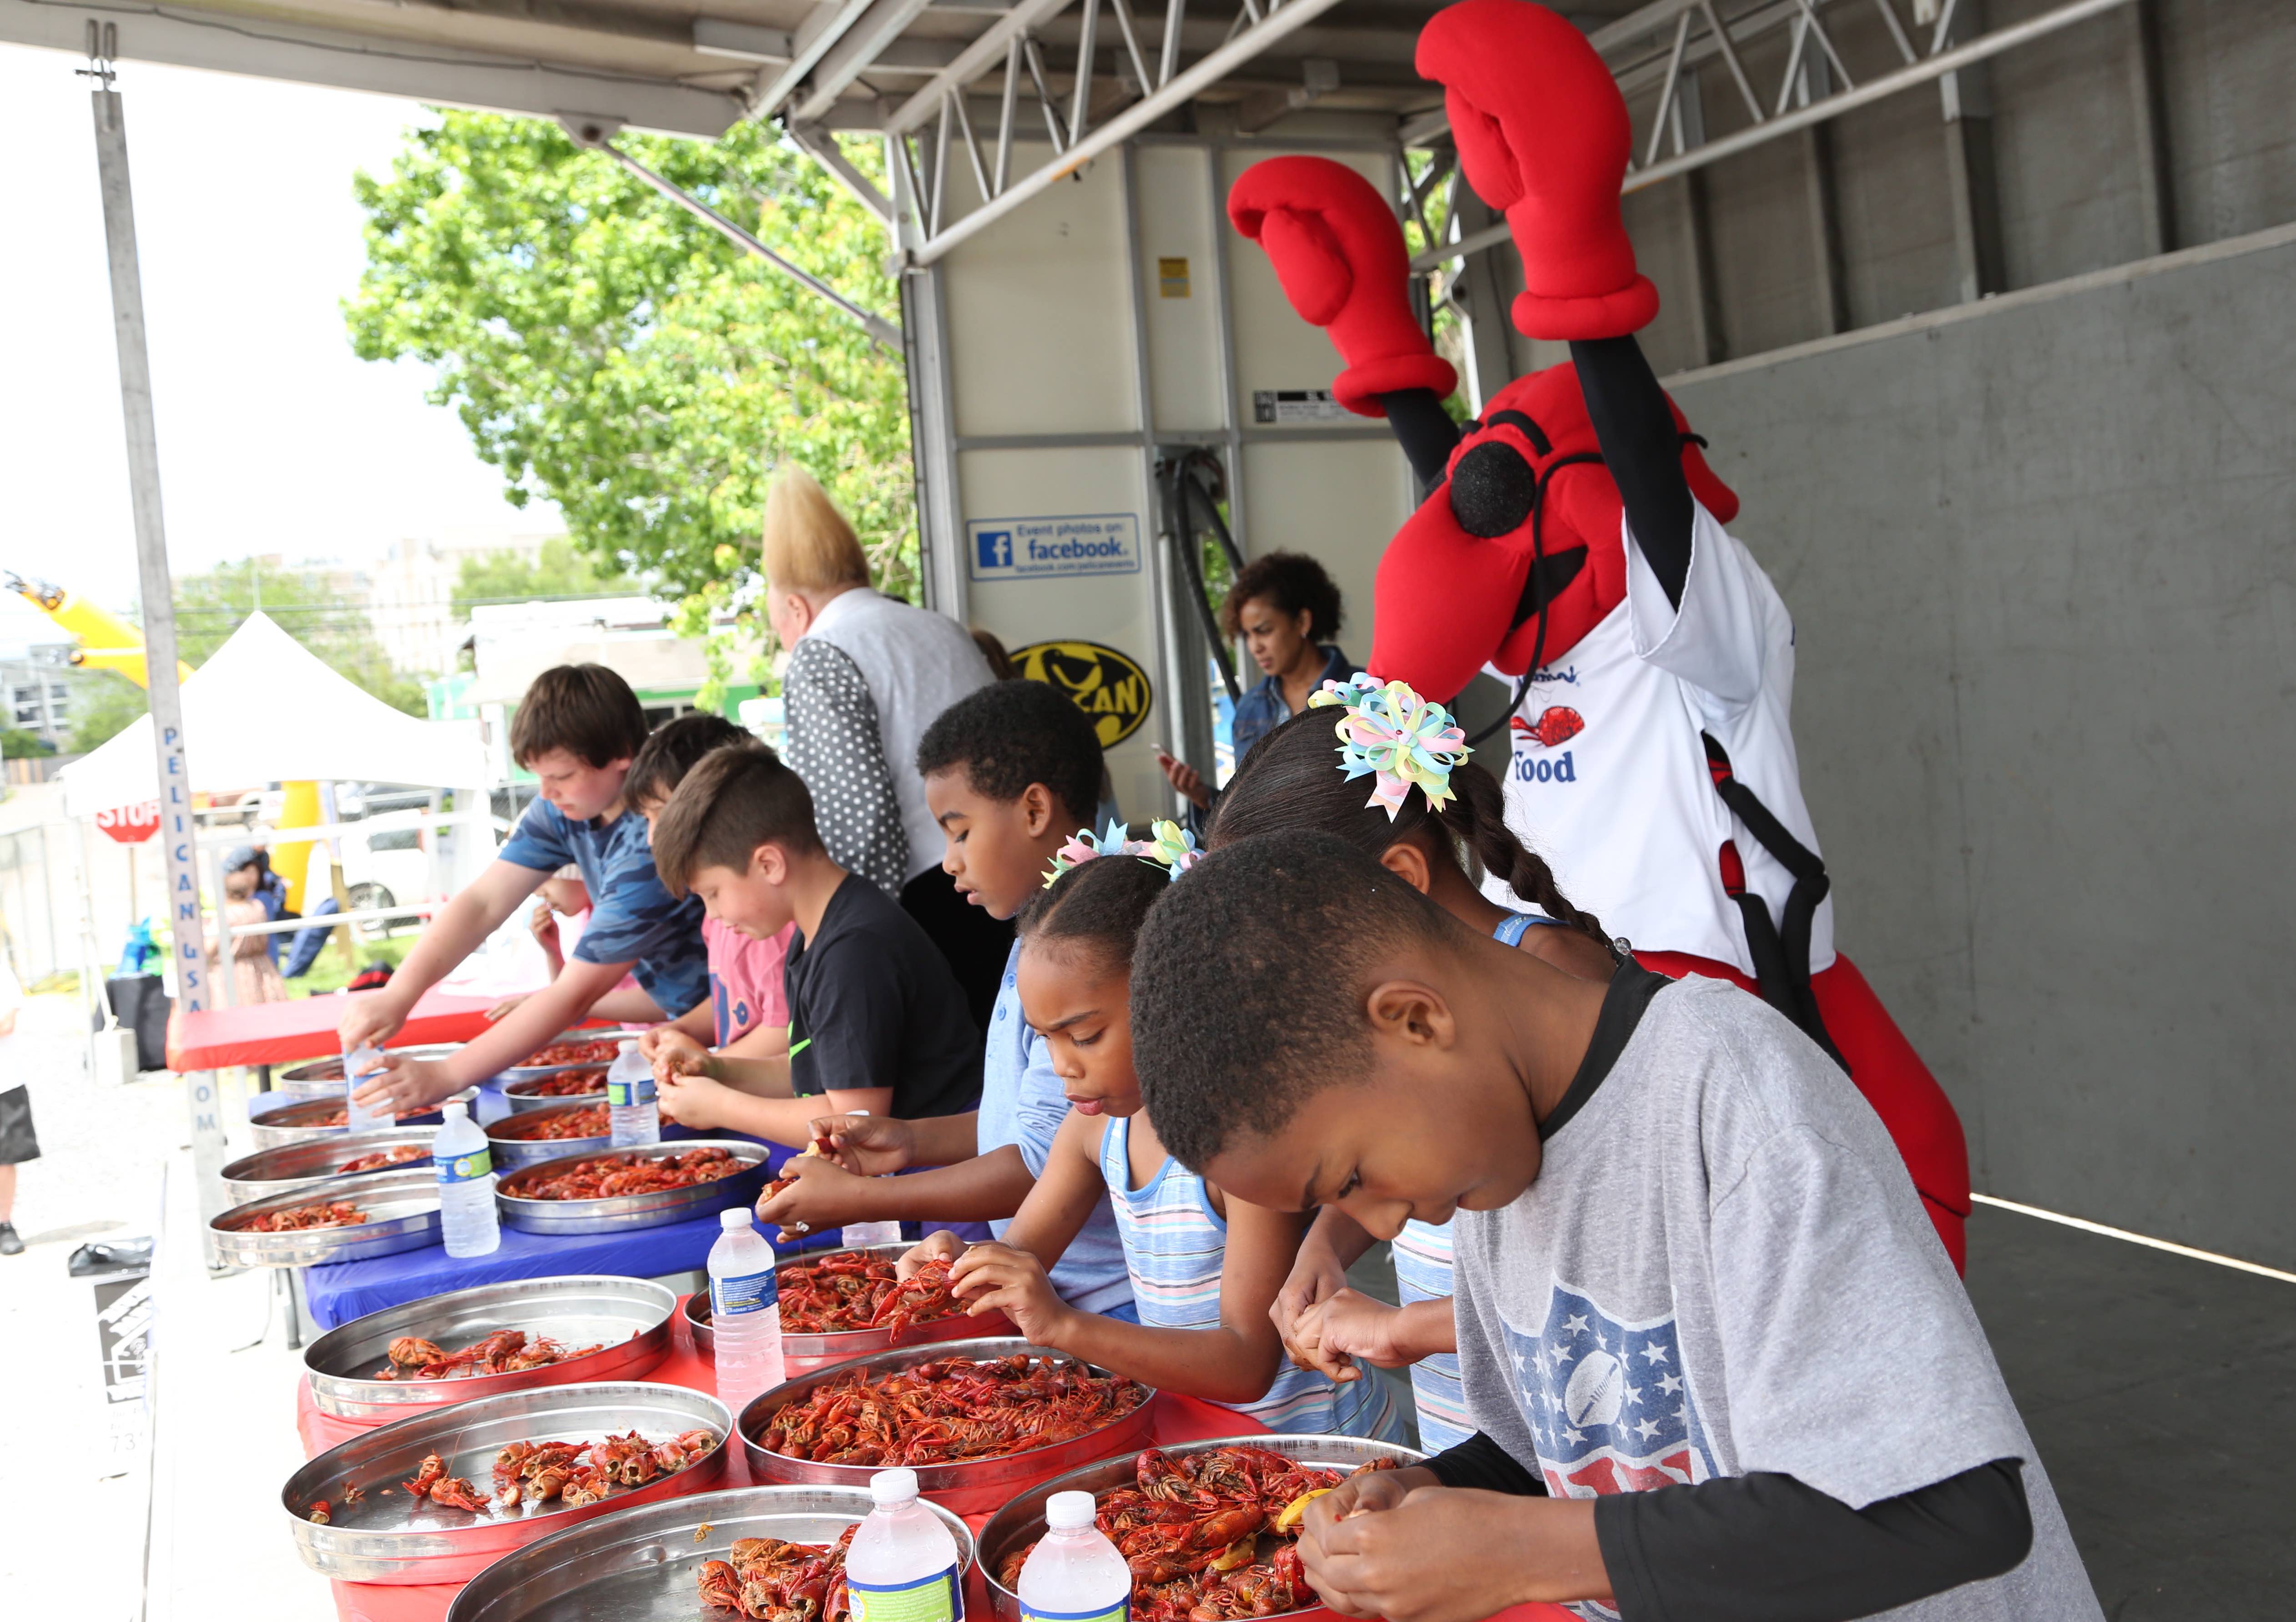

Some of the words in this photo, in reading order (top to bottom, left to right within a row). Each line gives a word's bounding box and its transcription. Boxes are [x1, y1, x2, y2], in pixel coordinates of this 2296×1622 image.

[1017, 524, 1052, 536] Event
[1057, 523, 1100, 536] photos
[1072, 674, 1137, 713] CAN
[98, 800, 160, 828] STOP
